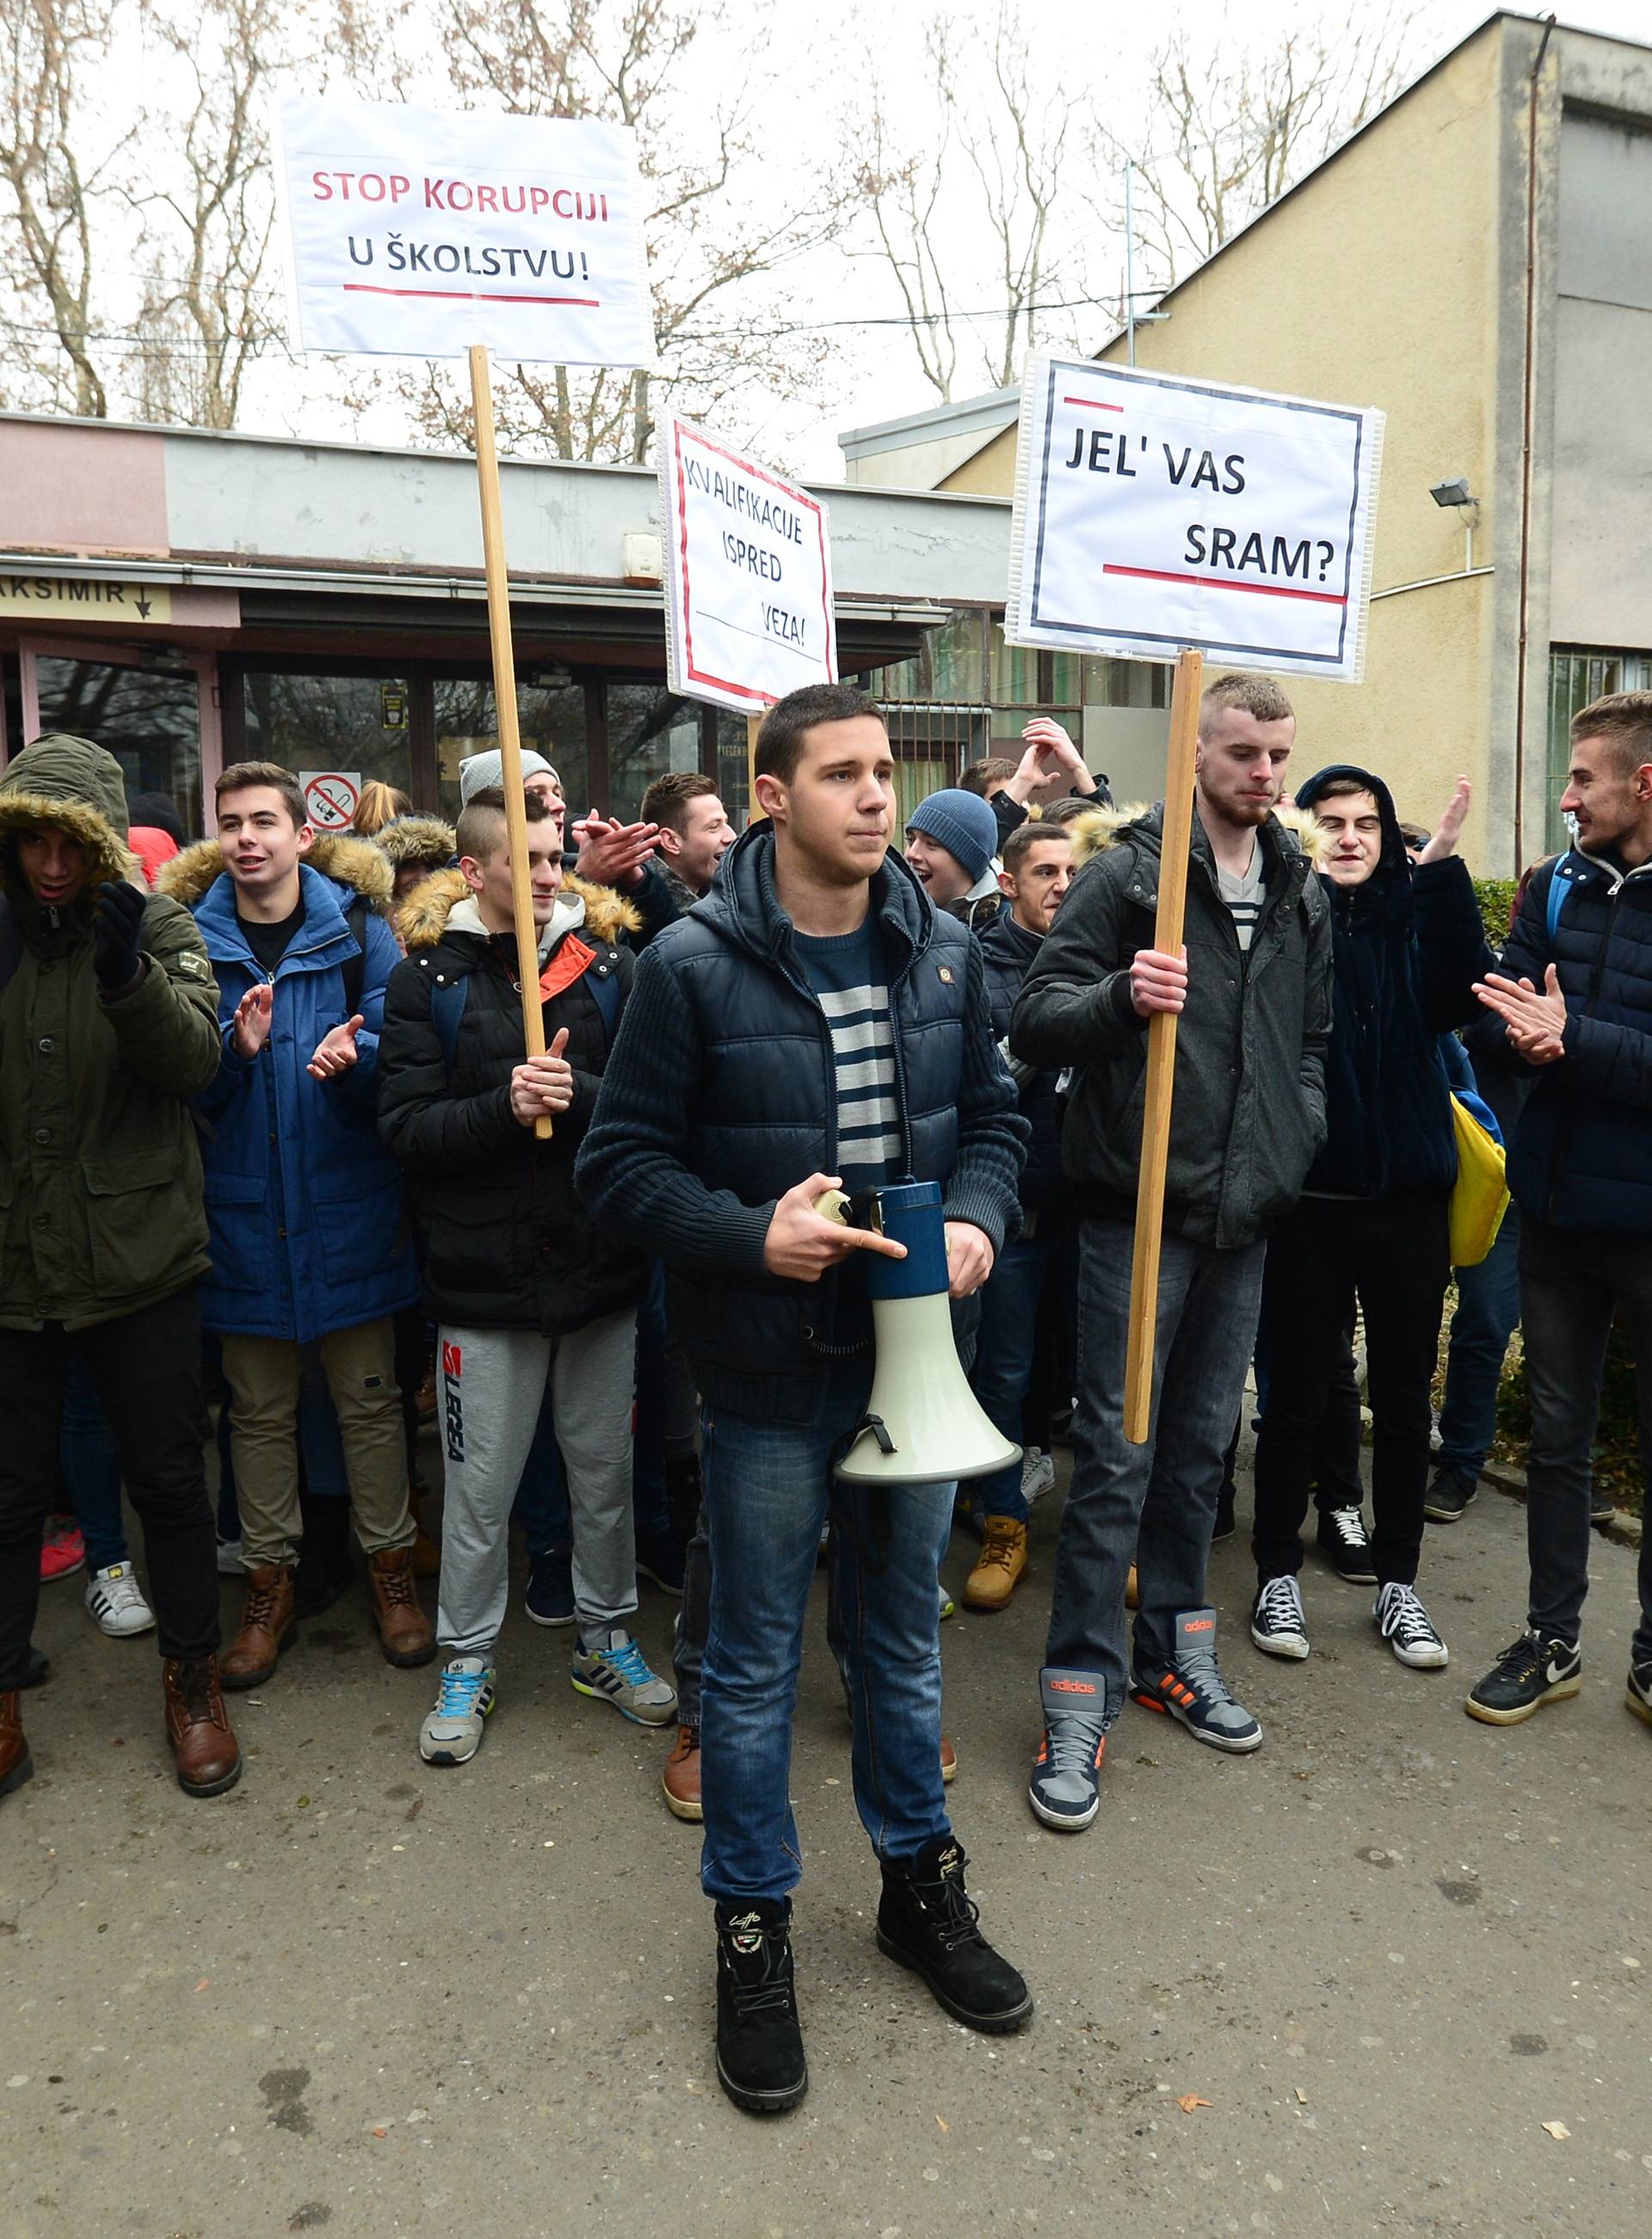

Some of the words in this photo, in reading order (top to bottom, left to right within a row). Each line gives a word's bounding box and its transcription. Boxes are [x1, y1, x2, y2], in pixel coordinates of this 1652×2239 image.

[311, 171, 410, 203] STOP
[424, 176, 608, 223] KORUPCIJI
[348, 236, 373, 266] U
[386, 231, 589, 281] ŠKOLSTVU!
[1065, 428, 1148, 477] JEL'
[1162, 442, 1246, 495] VAS
[684, 454, 803, 545] KVALIFIKACIJE
[722, 530, 782, 582] ISPRED
[1184, 524, 1335, 582] SRAM?
[761, 602, 805, 646] VEZA!
[1050, 1680, 1095, 1694] adidas
